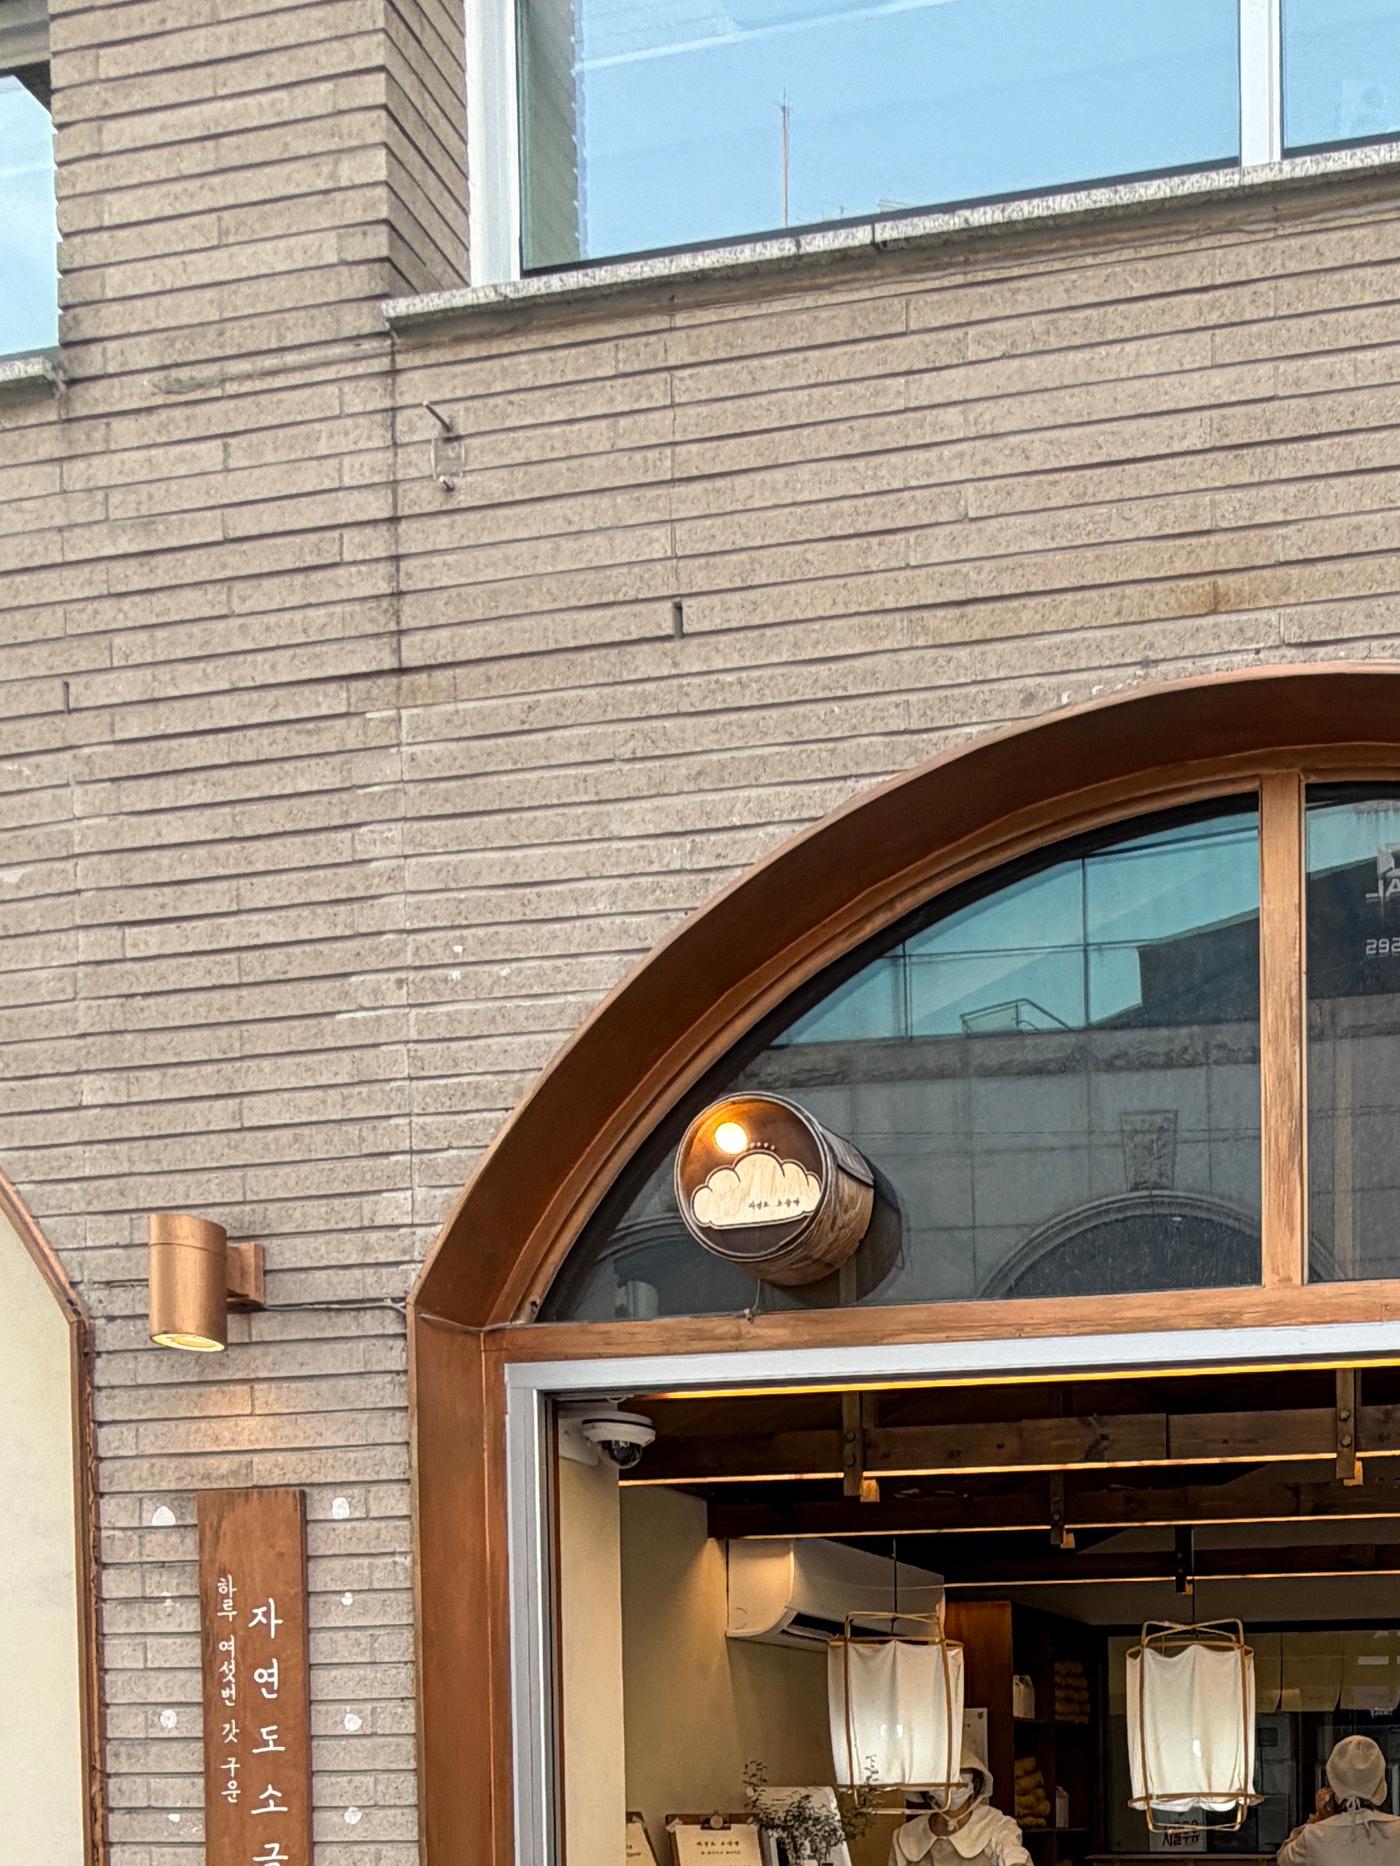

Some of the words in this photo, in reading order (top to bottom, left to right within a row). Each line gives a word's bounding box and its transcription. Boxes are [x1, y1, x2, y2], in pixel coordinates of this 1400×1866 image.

[216, 1574, 238, 1622] 하루
[218, 1634, 237, 1707] 여섯번
[221, 1719, 240, 1744] 갓
[219, 1757, 241, 1803] 구운
